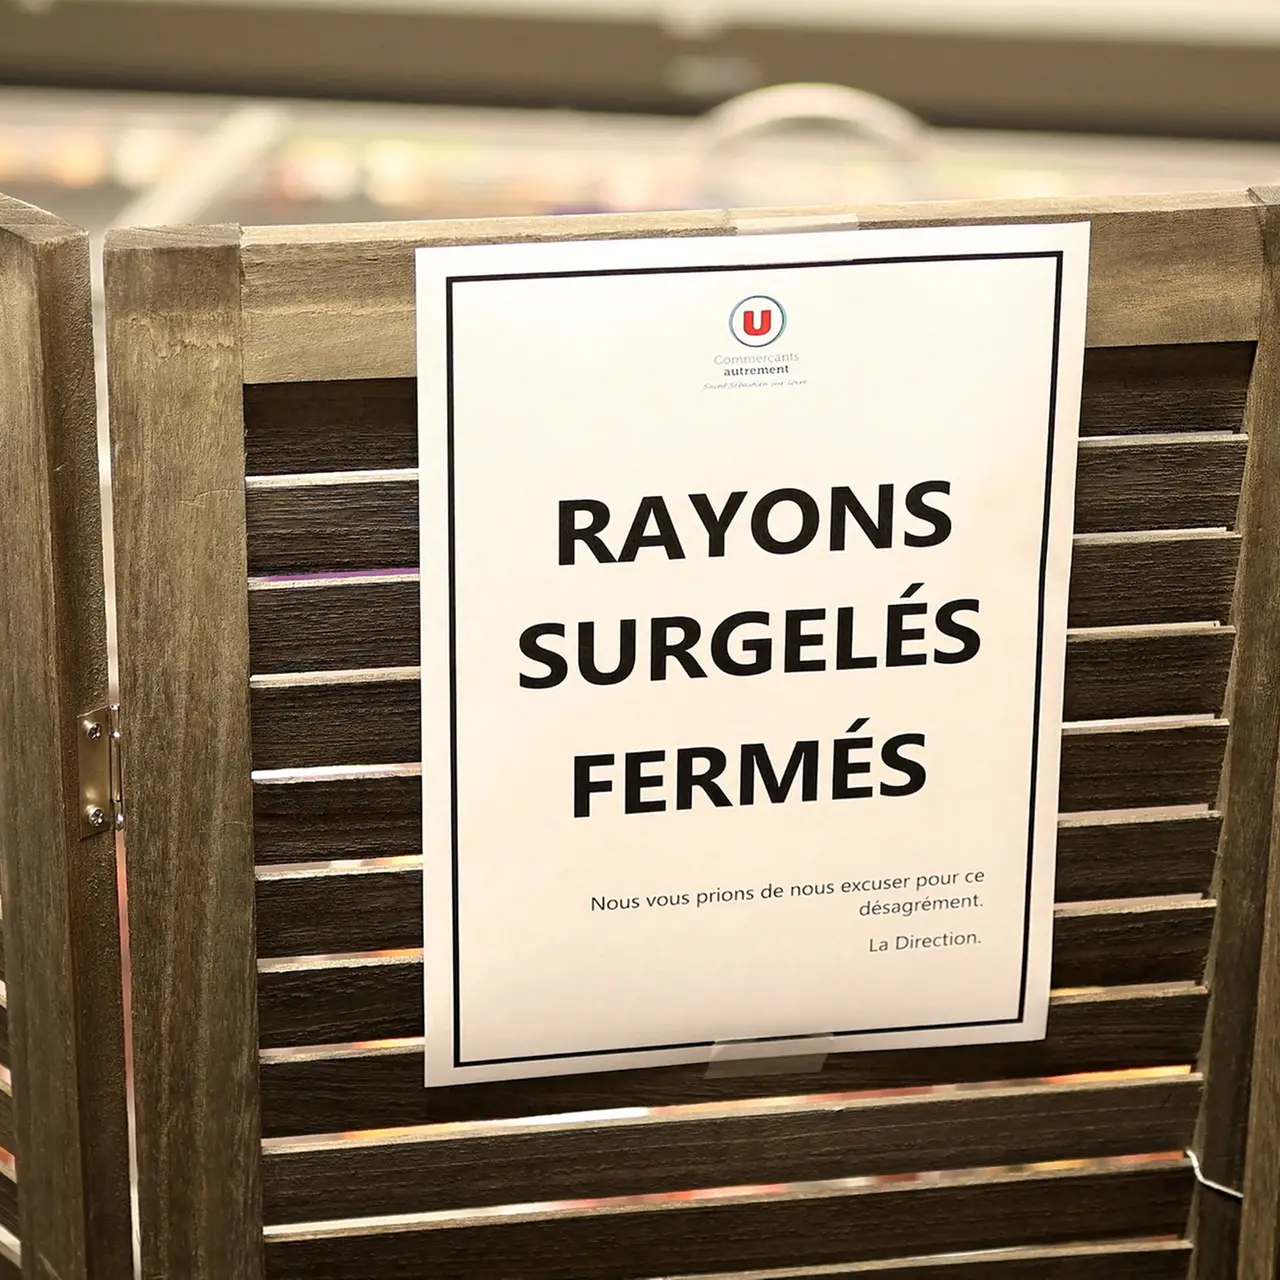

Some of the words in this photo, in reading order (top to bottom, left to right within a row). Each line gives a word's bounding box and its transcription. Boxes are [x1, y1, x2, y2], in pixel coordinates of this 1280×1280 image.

[743, 310, 771, 336] U
[713, 352, 800, 365] Commerçants
[723, 365, 790, 377] autrement
[558, 479, 952, 567] RAYONS
[518, 582, 981, 690] SURGELÉS
[573, 717, 927, 819] FERMÉS
[591, 896, 640, 912] Nous
[645, 893, 690, 908] vous
[696, 887, 755, 908] prions
[760, 883, 784, 900] de
[790, 883, 835, 897] nous
[840, 877, 911, 893] excuser
[916, 873, 960, 892] pour
[964, 871, 985, 884] ce
[859, 894, 983, 917] désagrément.
[869, 938, 889, 953] La
[895, 931, 982, 951] Direction.
